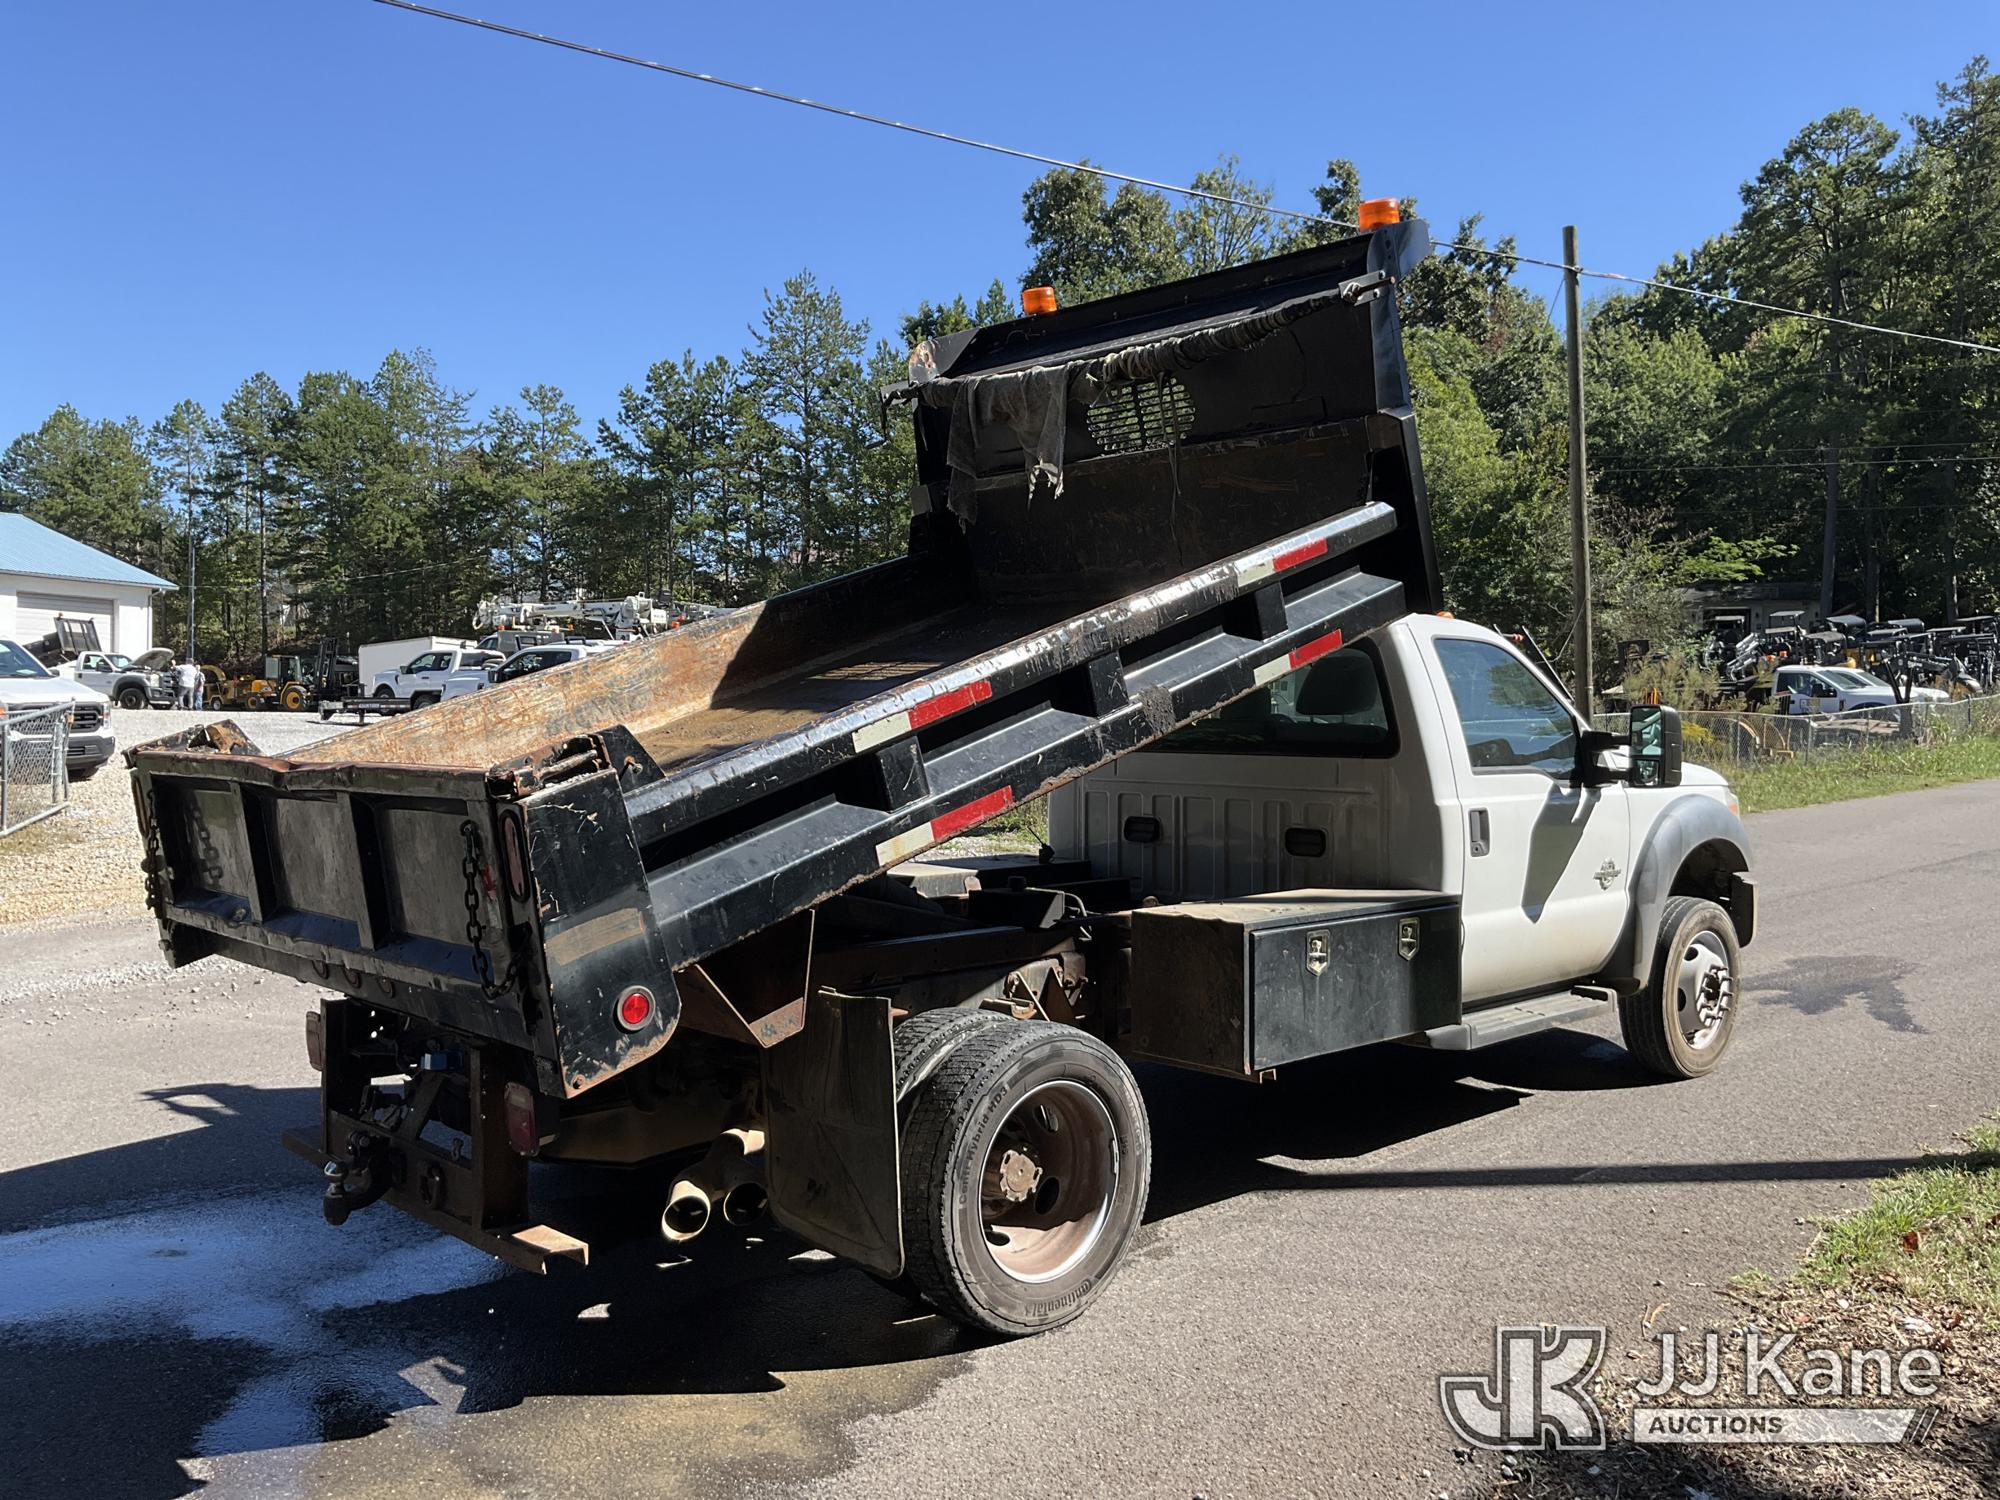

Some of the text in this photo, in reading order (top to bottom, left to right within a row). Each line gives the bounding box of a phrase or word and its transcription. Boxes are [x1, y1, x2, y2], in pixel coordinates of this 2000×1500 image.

[967, 1114, 990, 1161] Hybrid
[988, 1086, 1008, 1113] HD3
[1032, 1279, 1092, 1317] Continental
